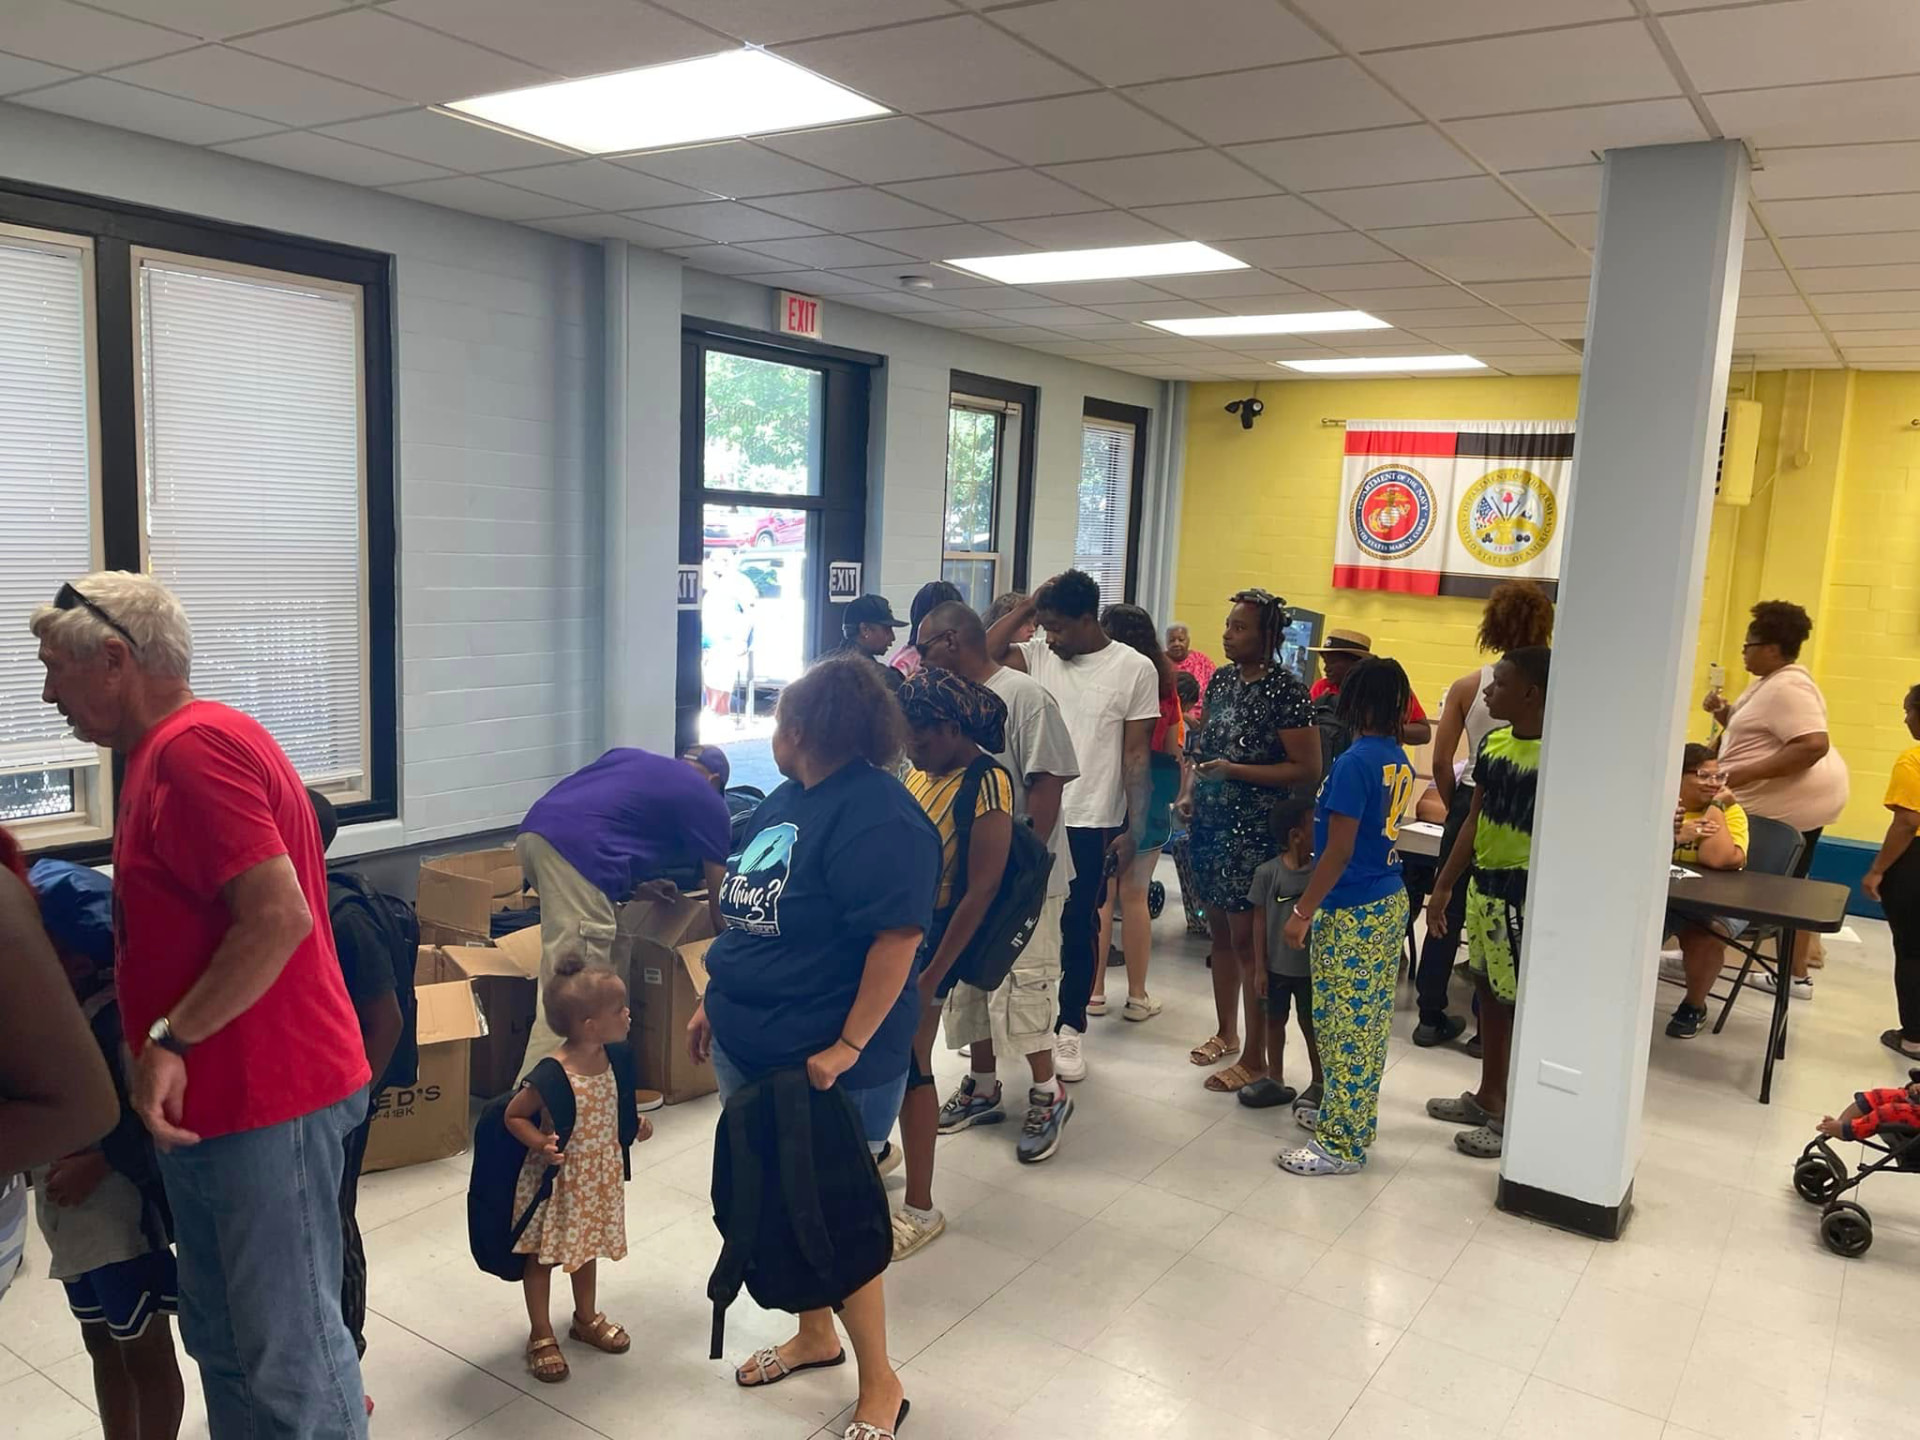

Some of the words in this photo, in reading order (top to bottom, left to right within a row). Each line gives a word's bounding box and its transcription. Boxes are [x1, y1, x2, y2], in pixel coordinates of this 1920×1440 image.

[788, 297, 817, 333] EXIT
[1397, 473, 1406, 481] OF
[1407, 478, 1418, 488] THE
[1416, 488, 1429, 511] NAVY
[1542, 493, 1554, 515] ARMY
[1389, 538, 1413, 551] MARINE
[1412, 518, 1426, 538] CORPS
[1525, 521, 1553, 556] AMERICA
[831, 569, 855, 591] EXIT
[376, 1085, 441, 1110] ED'S
